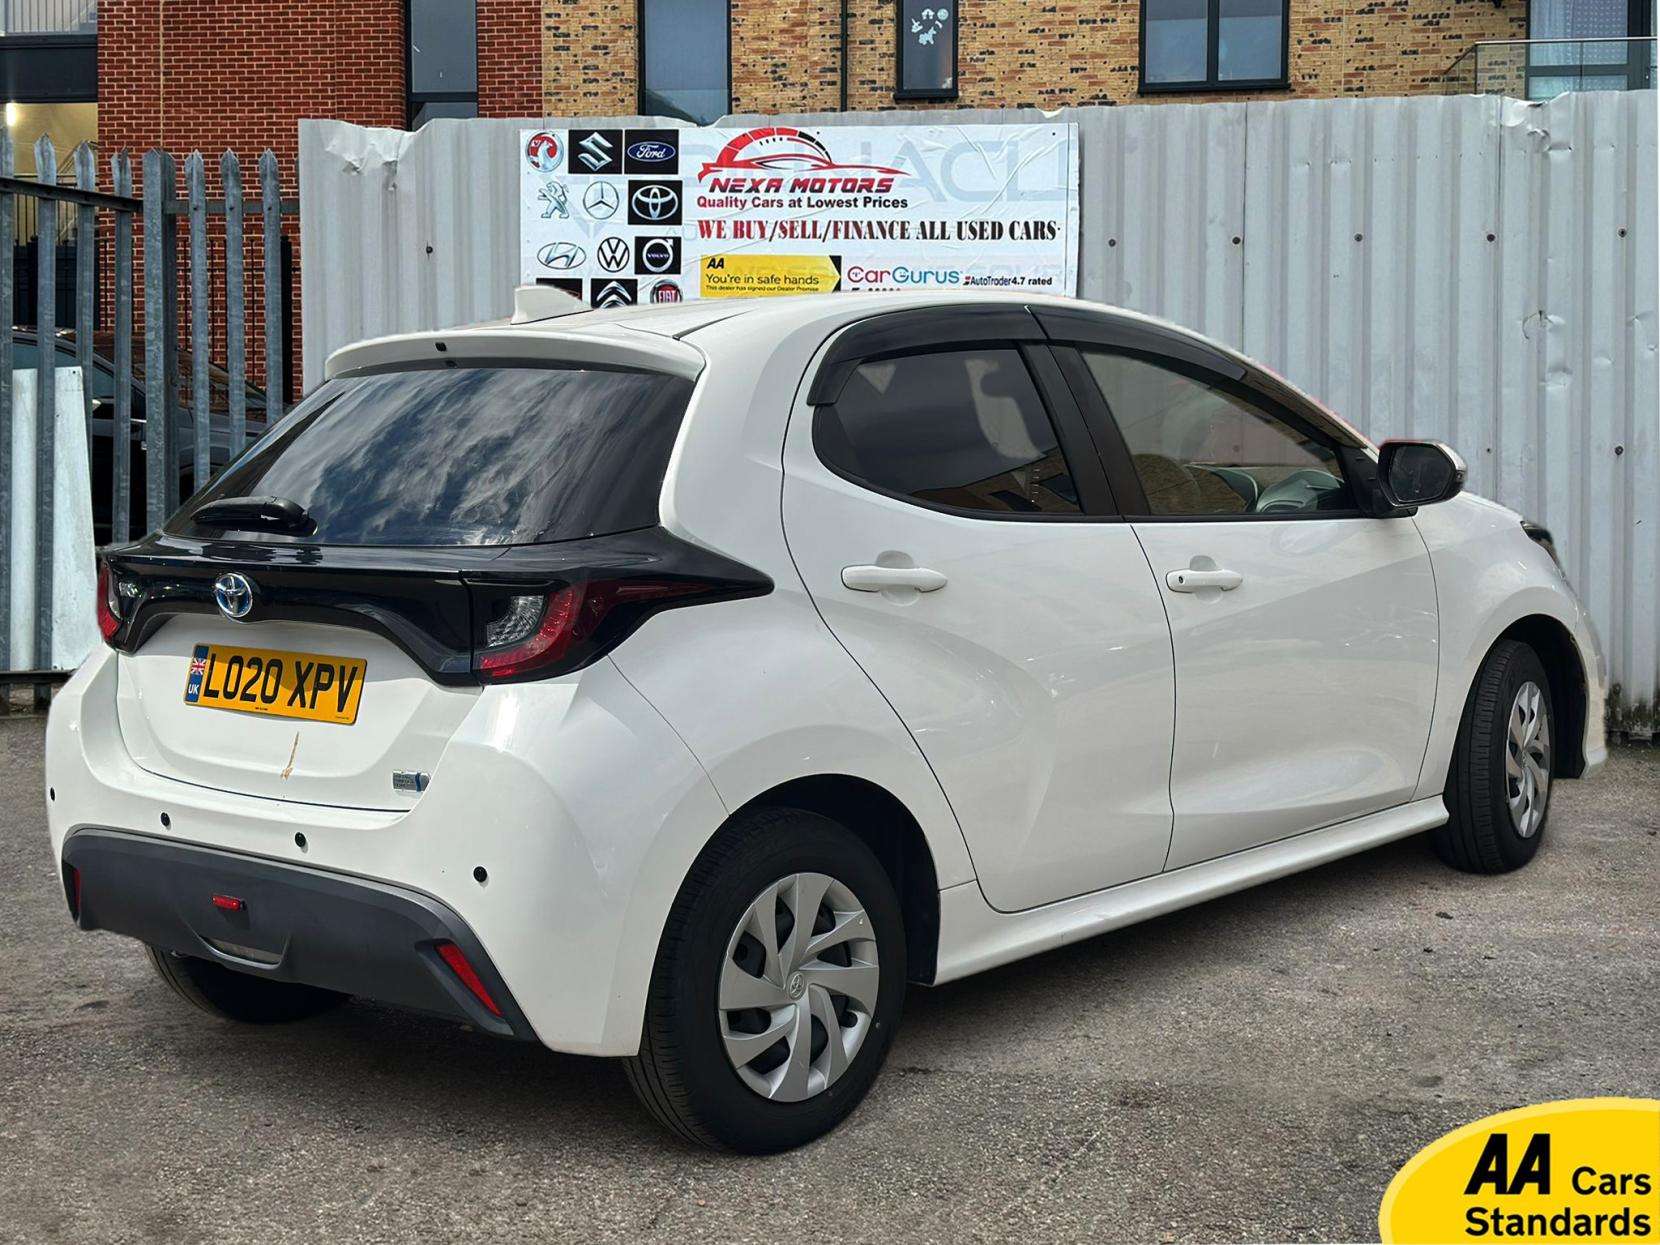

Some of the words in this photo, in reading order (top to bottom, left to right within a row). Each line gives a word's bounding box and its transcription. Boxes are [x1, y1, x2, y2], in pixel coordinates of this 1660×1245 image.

[636, 144, 666, 158] Ford
[709, 178, 783, 193] NEXA
[789, 178, 895, 193] MOTORS
[697, 196, 748, 210] Quality
[751, 196, 784, 208] Cars
[788, 197, 803, 208] at
[807, 197, 859, 208] Lowest
[863, 197, 908, 208] Prices
[697, 219, 727, 240] WE
[916, 220, 950, 240] ALL
[956, 220, 1004, 240] USED
[1008, 220, 1057, 240] CARS
[707, 257, 725, 269] AA
[706, 273, 741, 284] You're
[744, 273, 754, 284] in
[757, 273, 781, 285] safe
[784, 274, 819, 285] hands
[847, 266, 960, 284] CarGurus
[1028, 276, 1053, 286] rated
[658, 290, 676, 303] FIAT
[188, 684, 199, 695] UK
[287, 661, 358, 713] XPV
